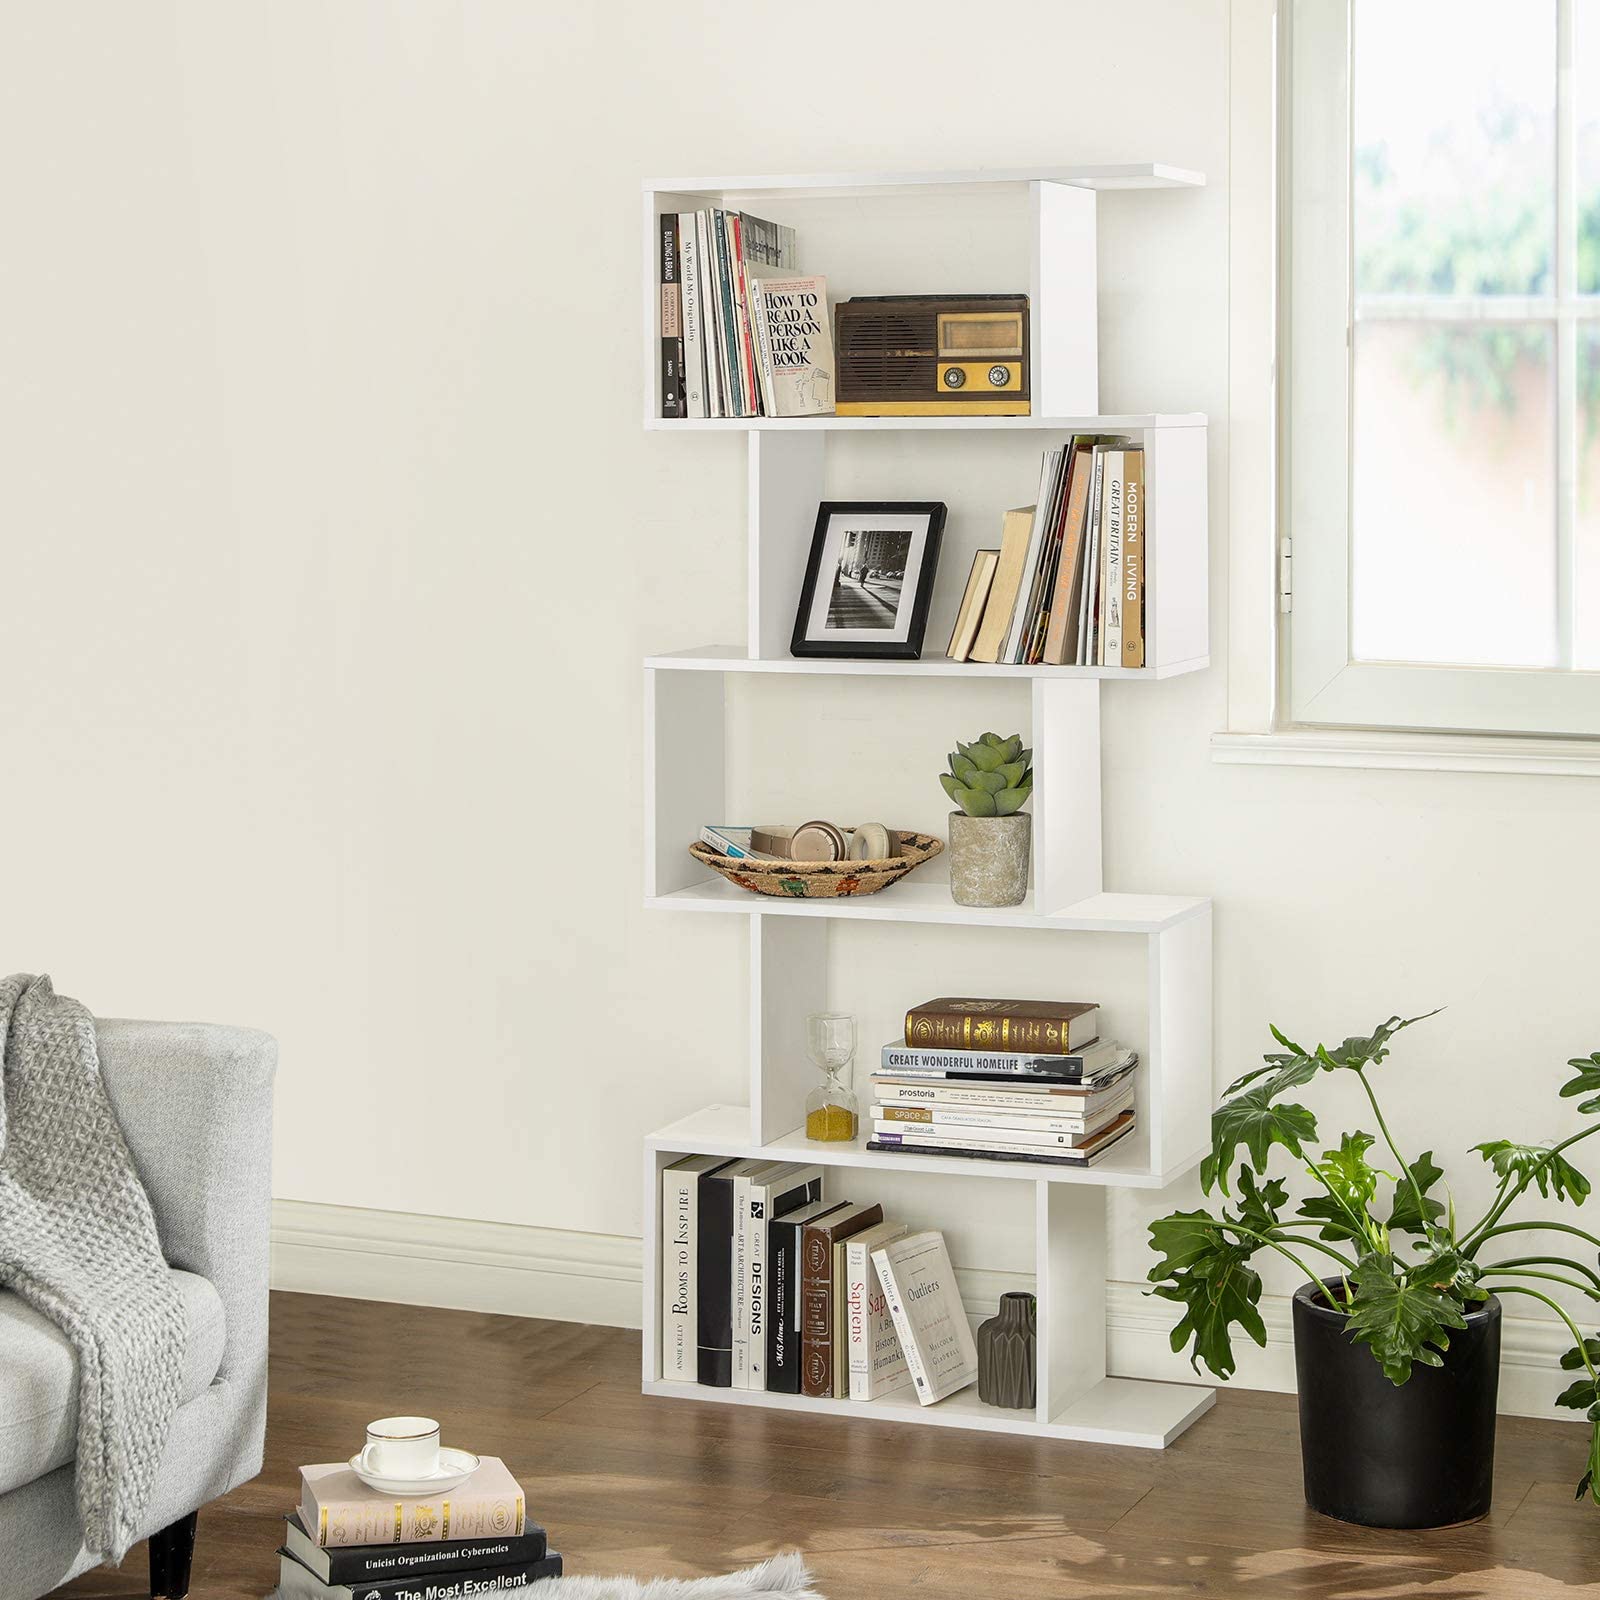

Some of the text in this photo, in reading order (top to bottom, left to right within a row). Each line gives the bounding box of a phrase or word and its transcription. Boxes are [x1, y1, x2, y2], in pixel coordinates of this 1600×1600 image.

[684, 242, 692, 254] My
[685, 284, 694, 296] My
[764, 293, 817, 309] HOW TO
[687, 298, 696, 342] Originality
[767, 308, 813, 324] READ A
[768, 322, 821, 337] PERSON
[770, 337, 811, 352] LIKE A
[773, 352, 811, 366] BOOK
[1110, 480, 1120, 517] GREAT
[1110, 519, 1120, 565] BRITAIN
[1127, 482, 1137, 601] MODERN LIVING
[889, 1054, 1019, 1071] CREATE WONDERFUL HOMELIFE
[899, 1089, 935, 1098] prostoria
[811, 1245, 819, 1266] ITALY
[881, 1270, 896, 1302] Outliers
[907, 1280, 939, 1302] Outliers
[751, 1262, 761, 1335] DESIGNS
[847, 1282, 865, 1343] Sapiens
[874, 1335, 897, 1352] History
[811, 1359, 819, 1381] ITALY
[873, 1348, 905, 1371] Humanki
[365, 1543, 509, 1570] Unicist Organizational Cybernetics
[395, 1572, 528, 1600] The Most Excellent
